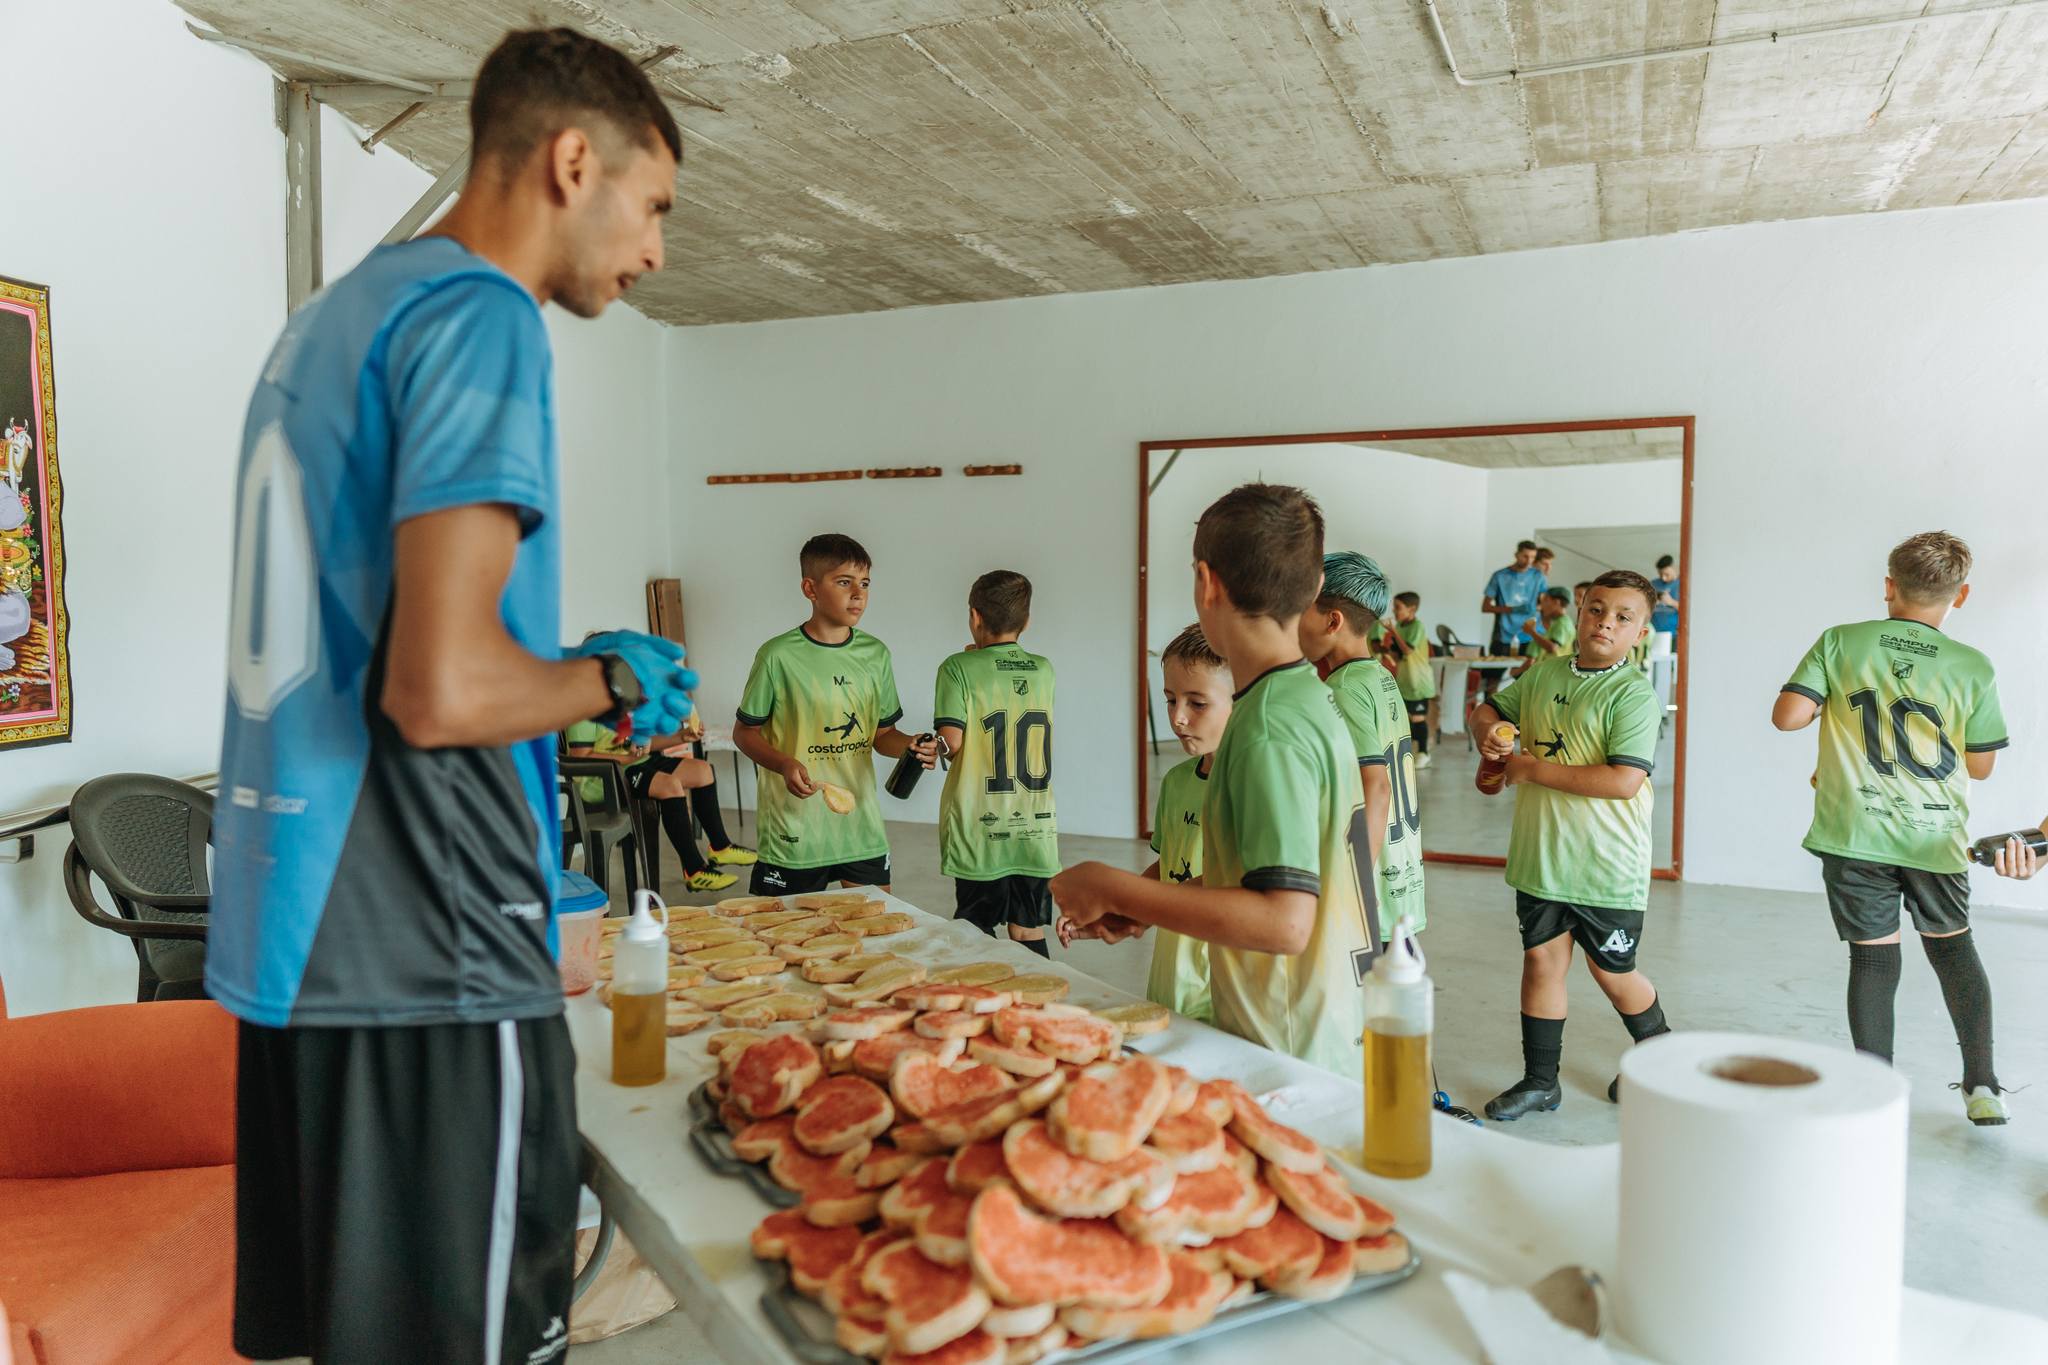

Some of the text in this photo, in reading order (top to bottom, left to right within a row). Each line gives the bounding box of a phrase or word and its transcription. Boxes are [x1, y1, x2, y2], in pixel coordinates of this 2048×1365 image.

[1880, 634, 1938, 651] CAMPUS
[980, 709, 1052, 794] 10
[1846, 687, 1959, 783] 10
[1383, 735, 1420, 845] 10
